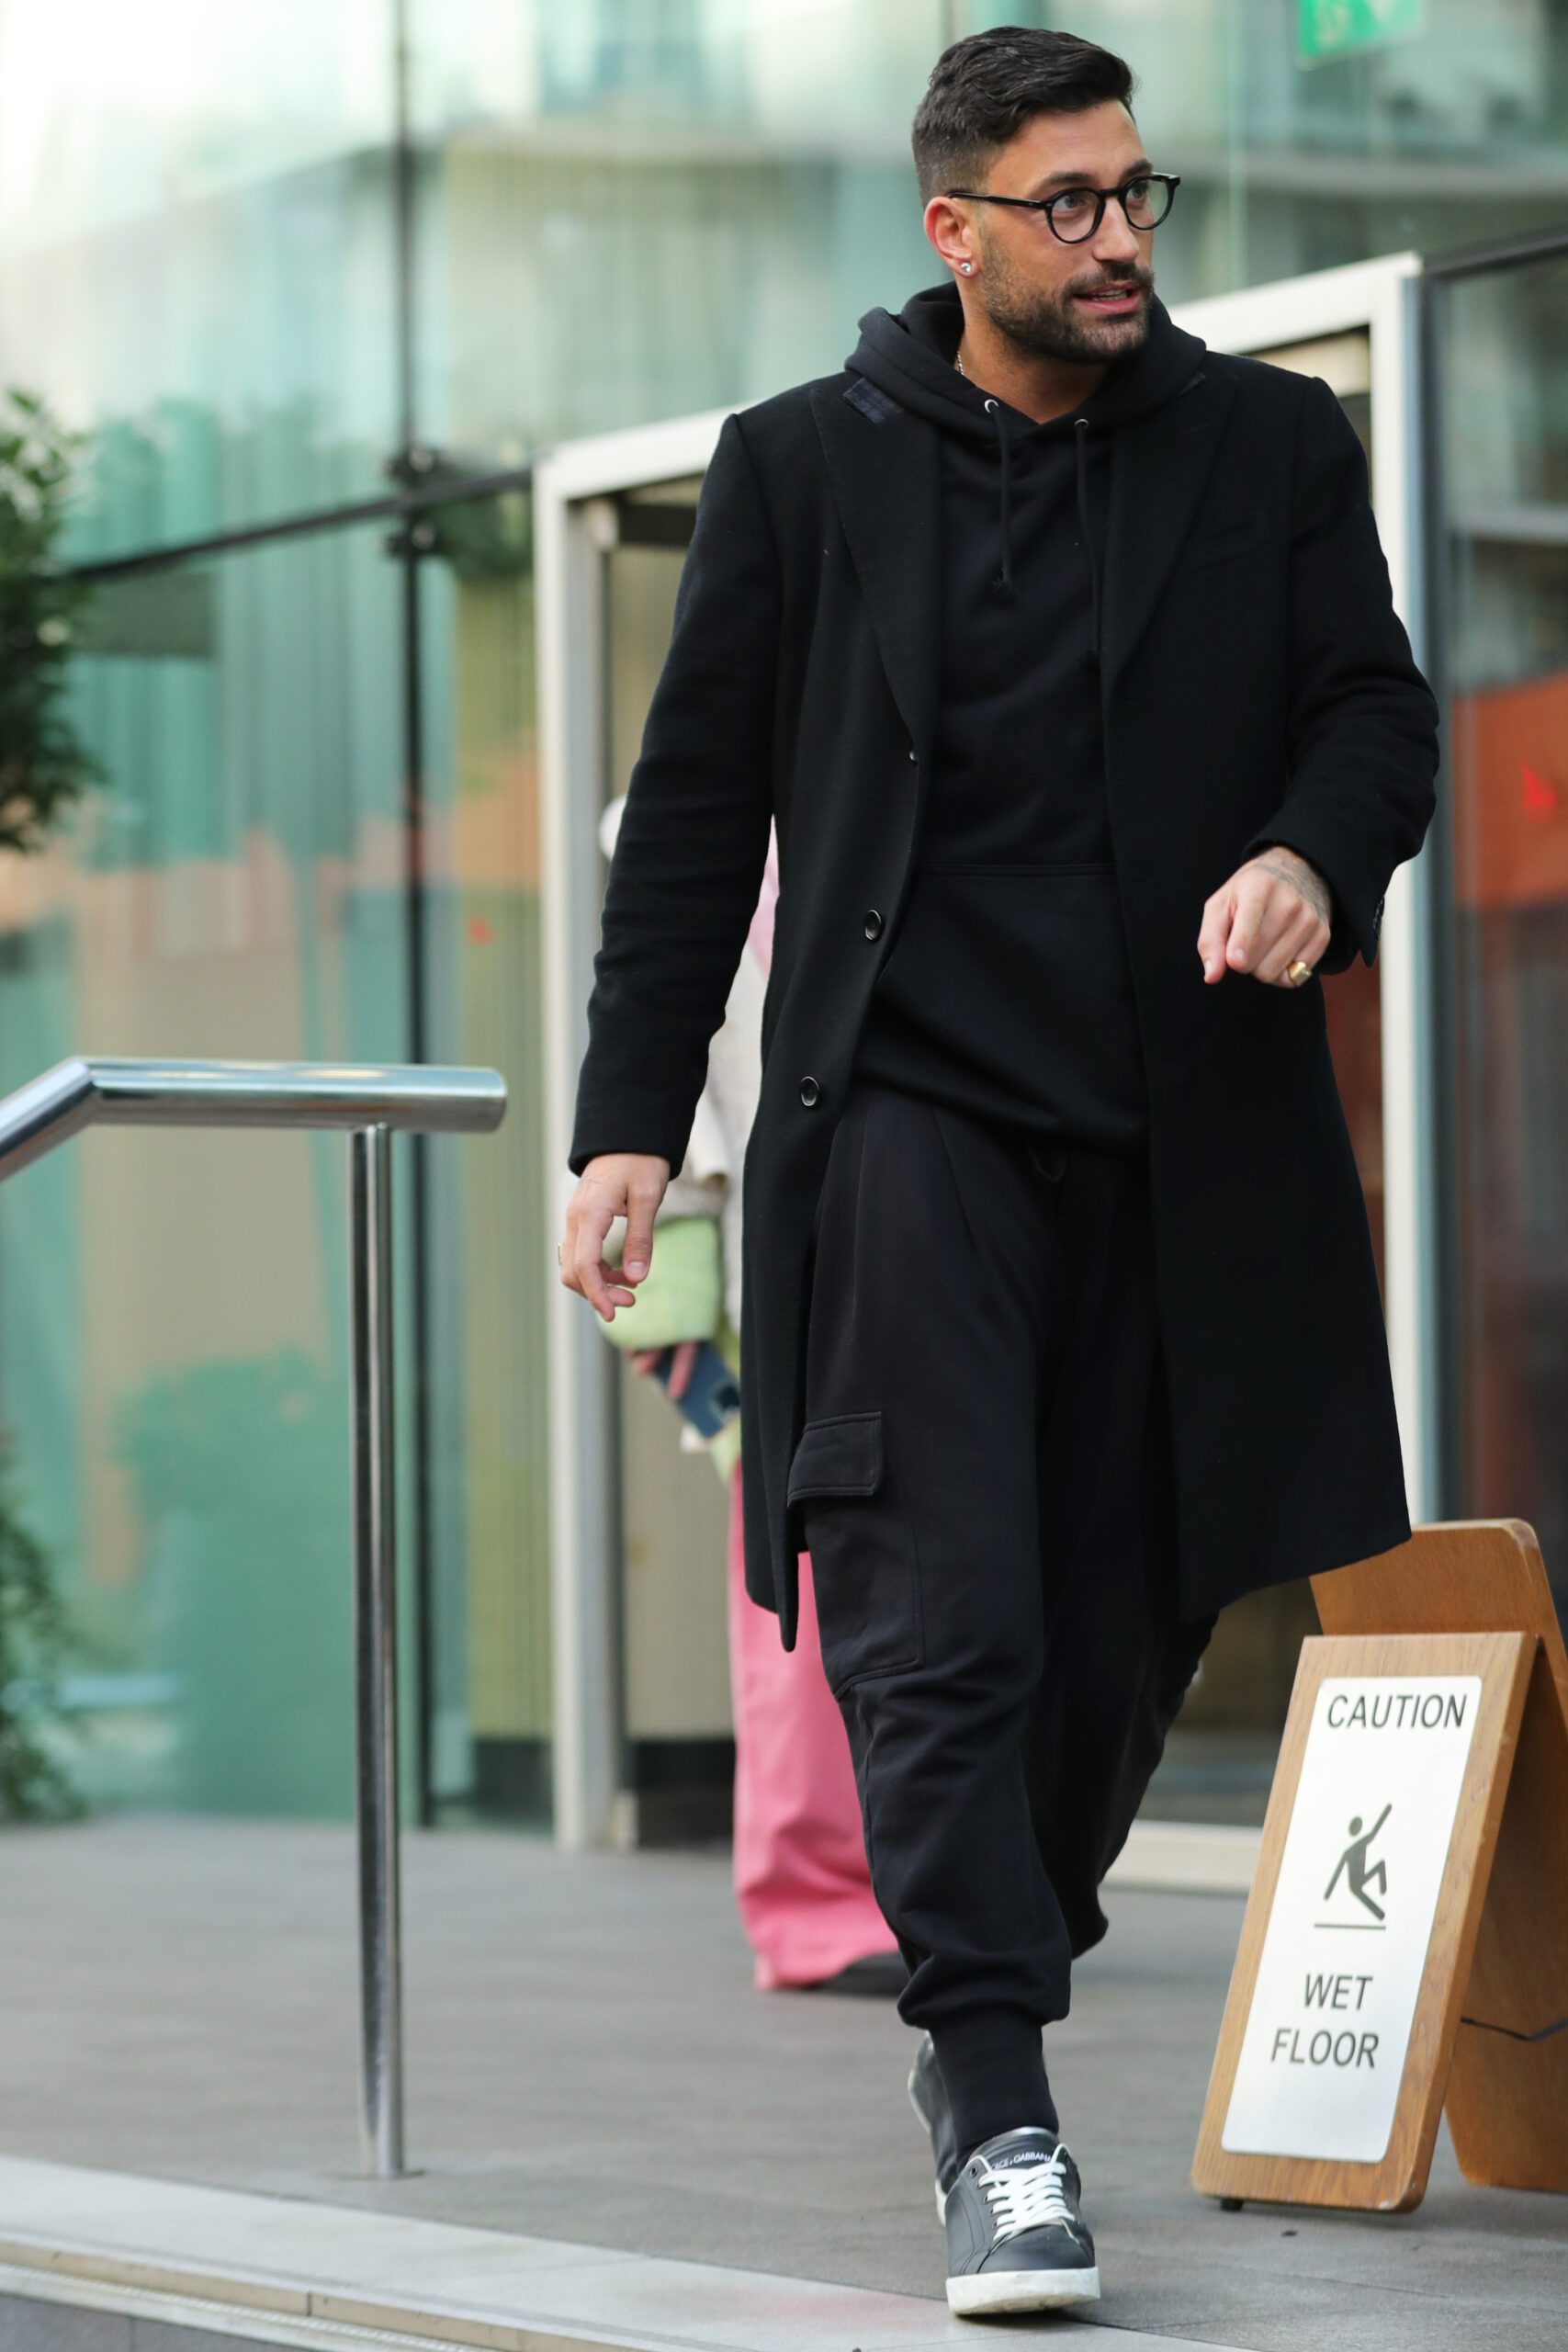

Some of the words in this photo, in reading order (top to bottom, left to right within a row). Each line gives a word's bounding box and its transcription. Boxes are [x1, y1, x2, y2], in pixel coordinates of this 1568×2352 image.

[1328, 1694, 1467, 1728] CAUTION
[1304, 1973, 1373, 2010] WET
[1270, 2029, 1379, 2069] FLOOR
